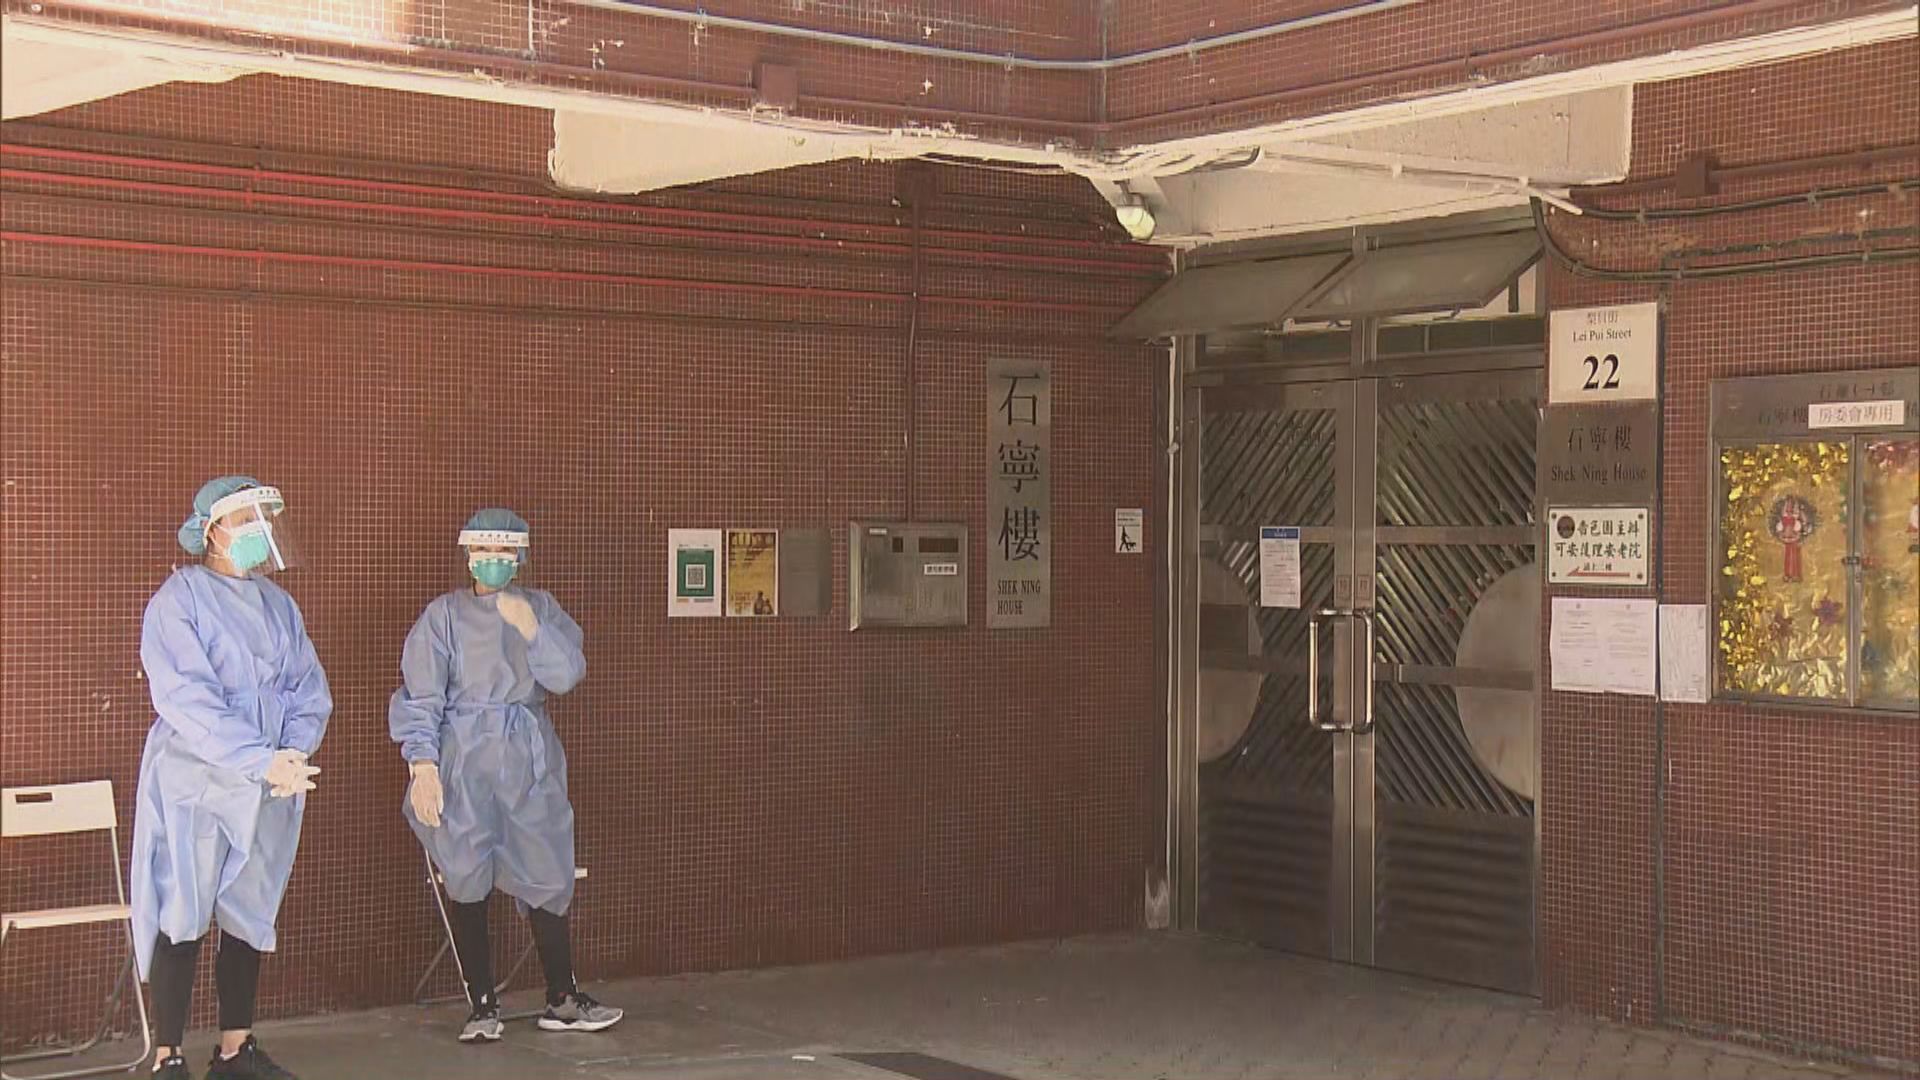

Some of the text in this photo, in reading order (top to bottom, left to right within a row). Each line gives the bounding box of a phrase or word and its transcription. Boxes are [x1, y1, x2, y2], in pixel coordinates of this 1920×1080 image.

[1573, 327, 1632, 342] Lei Pui Street
[1583, 354, 1620, 390] 22
[1567, 426, 1632, 452] 石寧樓
[998, 372, 1041, 561] 石寧樓
[1552, 463, 1649, 485] Shek Ning House
[997, 578, 1041, 595] SHEK NING
[997, 600, 1024, 615] HOUSE
